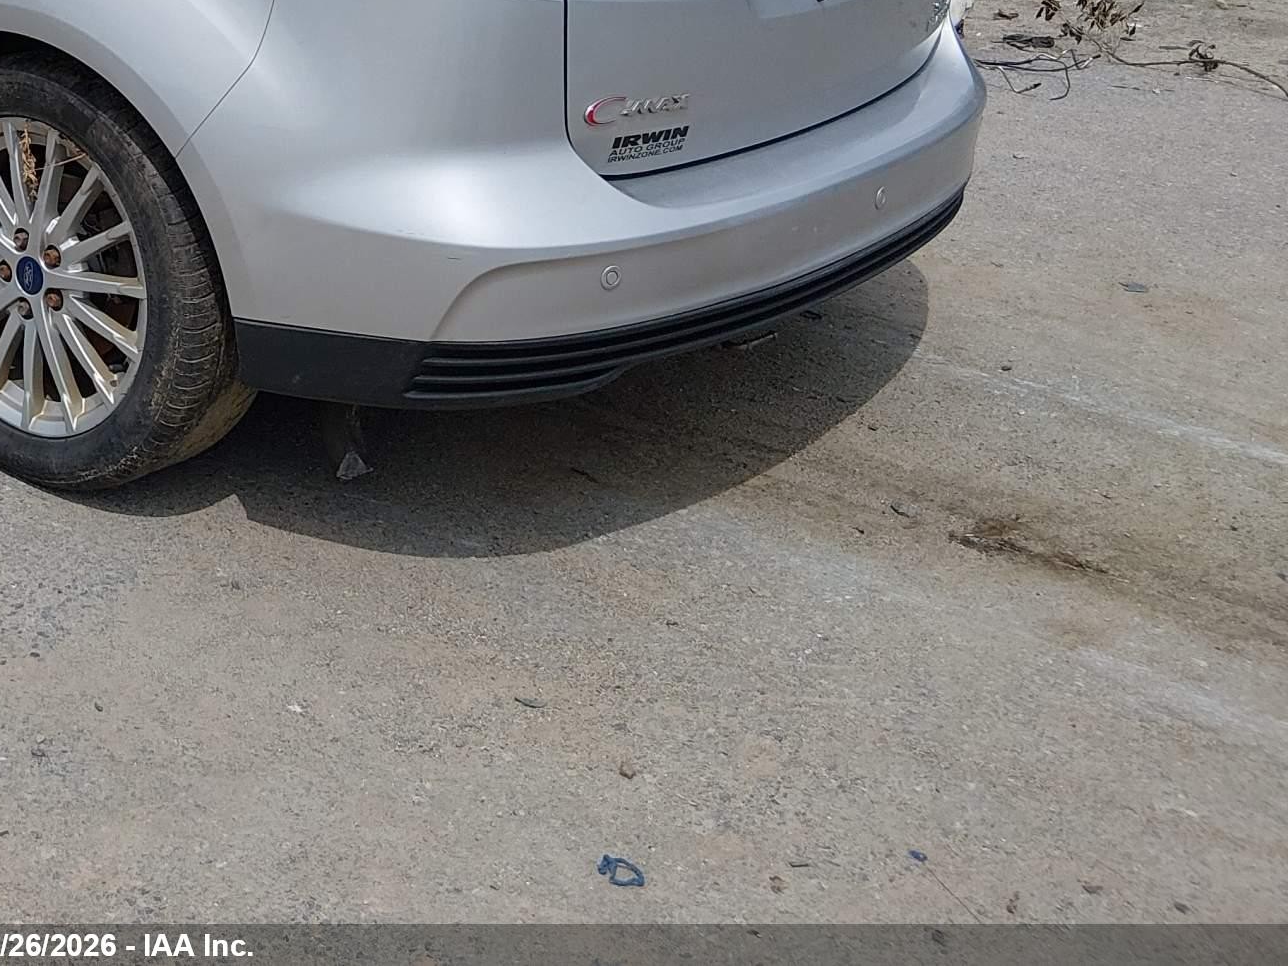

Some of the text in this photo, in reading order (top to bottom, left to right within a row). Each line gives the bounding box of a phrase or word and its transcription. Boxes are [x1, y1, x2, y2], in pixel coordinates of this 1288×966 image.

[609, 137, 686, 157] AUTO GROUP
[612, 125, 690, 149] IRWIN
[607, 144, 685, 164] IRWINZONE.COM
